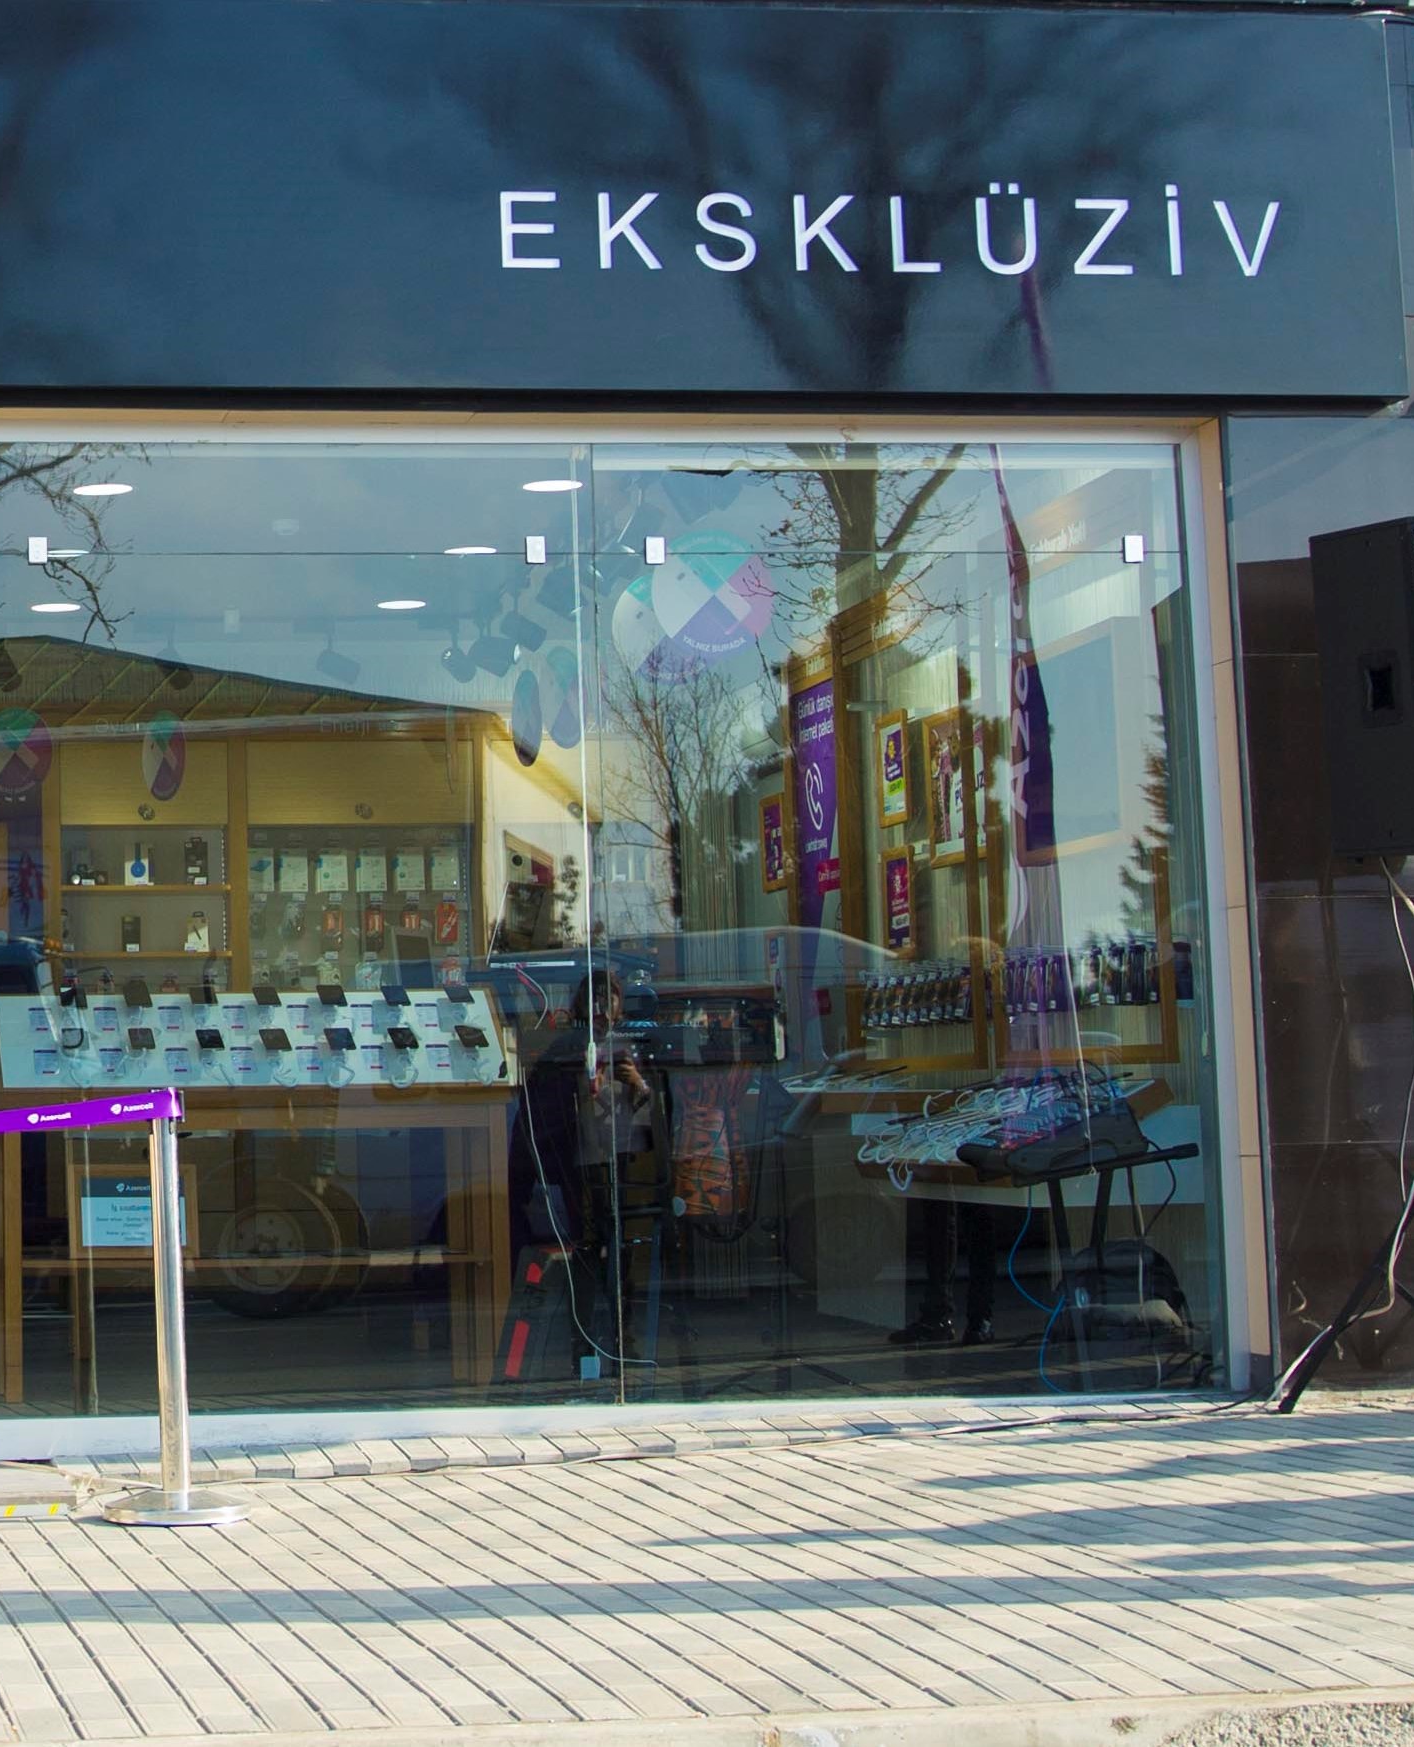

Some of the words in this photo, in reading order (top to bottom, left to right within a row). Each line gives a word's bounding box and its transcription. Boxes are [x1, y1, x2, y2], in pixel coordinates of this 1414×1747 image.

[499, 182, 1280, 277] EKSKLÜZİV
[39, 1112, 71, 1122] Azercell
[123, 1103, 154, 1112] Azercell
